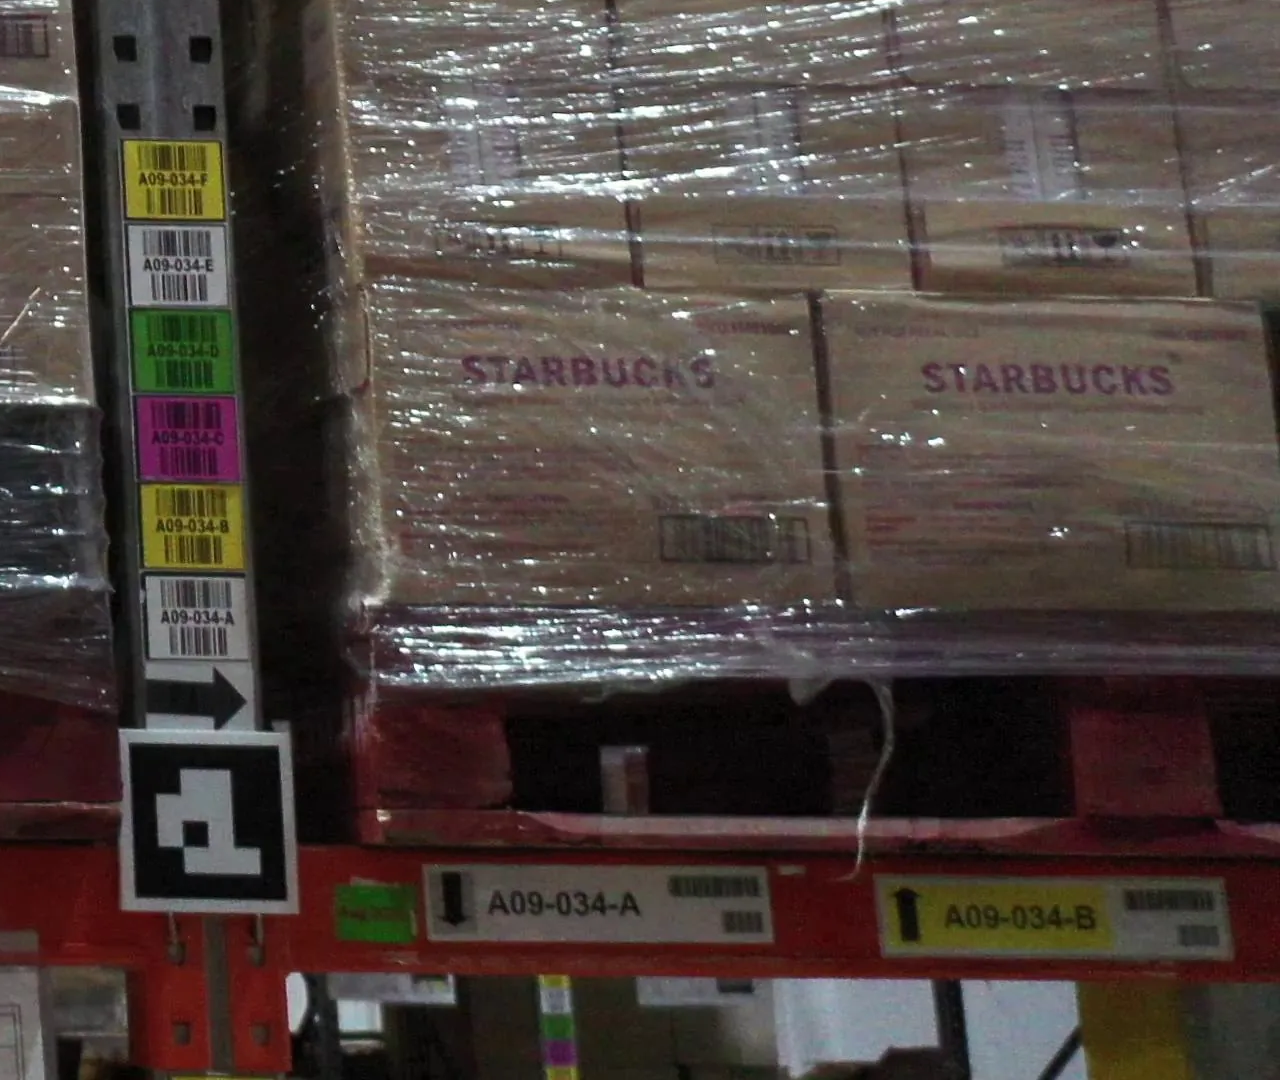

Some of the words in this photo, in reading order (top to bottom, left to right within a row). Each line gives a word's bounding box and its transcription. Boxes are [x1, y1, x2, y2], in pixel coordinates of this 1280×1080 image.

[138, 171, 209, 187] A09-034-F
[143, 257, 214, 273] A09-034-E
[147, 343, 220, 358] A09-034-D
[461, 354, 717, 389] STARBUCKS
[922, 362, 1175, 396] STARBUCKS
[151, 430, 225, 446] A09-034-C
[155, 518, 230, 535] A09-034-B
[160, 609, 235, 626] A09-034-A
[486, 889, 641, 920] A09-034-A
[943, 902, 1097, 933] A09-034-B
